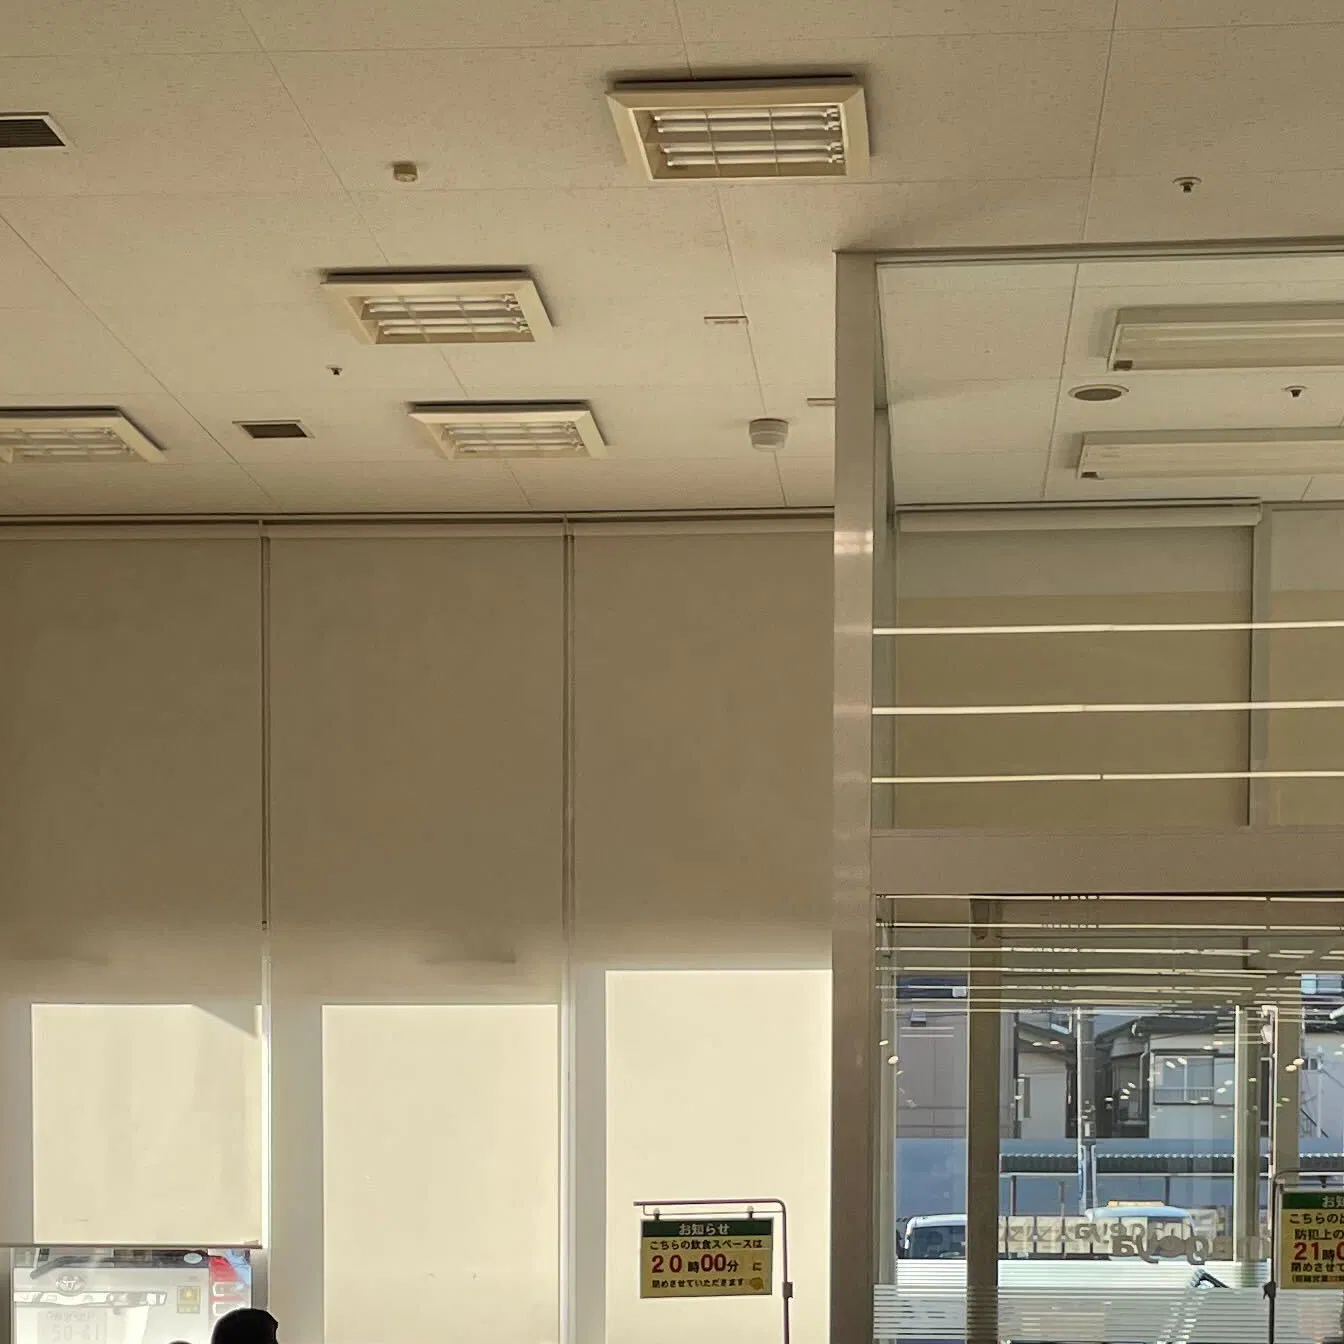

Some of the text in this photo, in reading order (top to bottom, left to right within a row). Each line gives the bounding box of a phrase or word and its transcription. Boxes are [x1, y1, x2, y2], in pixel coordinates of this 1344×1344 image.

[679, 1223, 730, 1236] お知らせ
[650, 1239, 763, 1250] こちらの飲食スペースは
